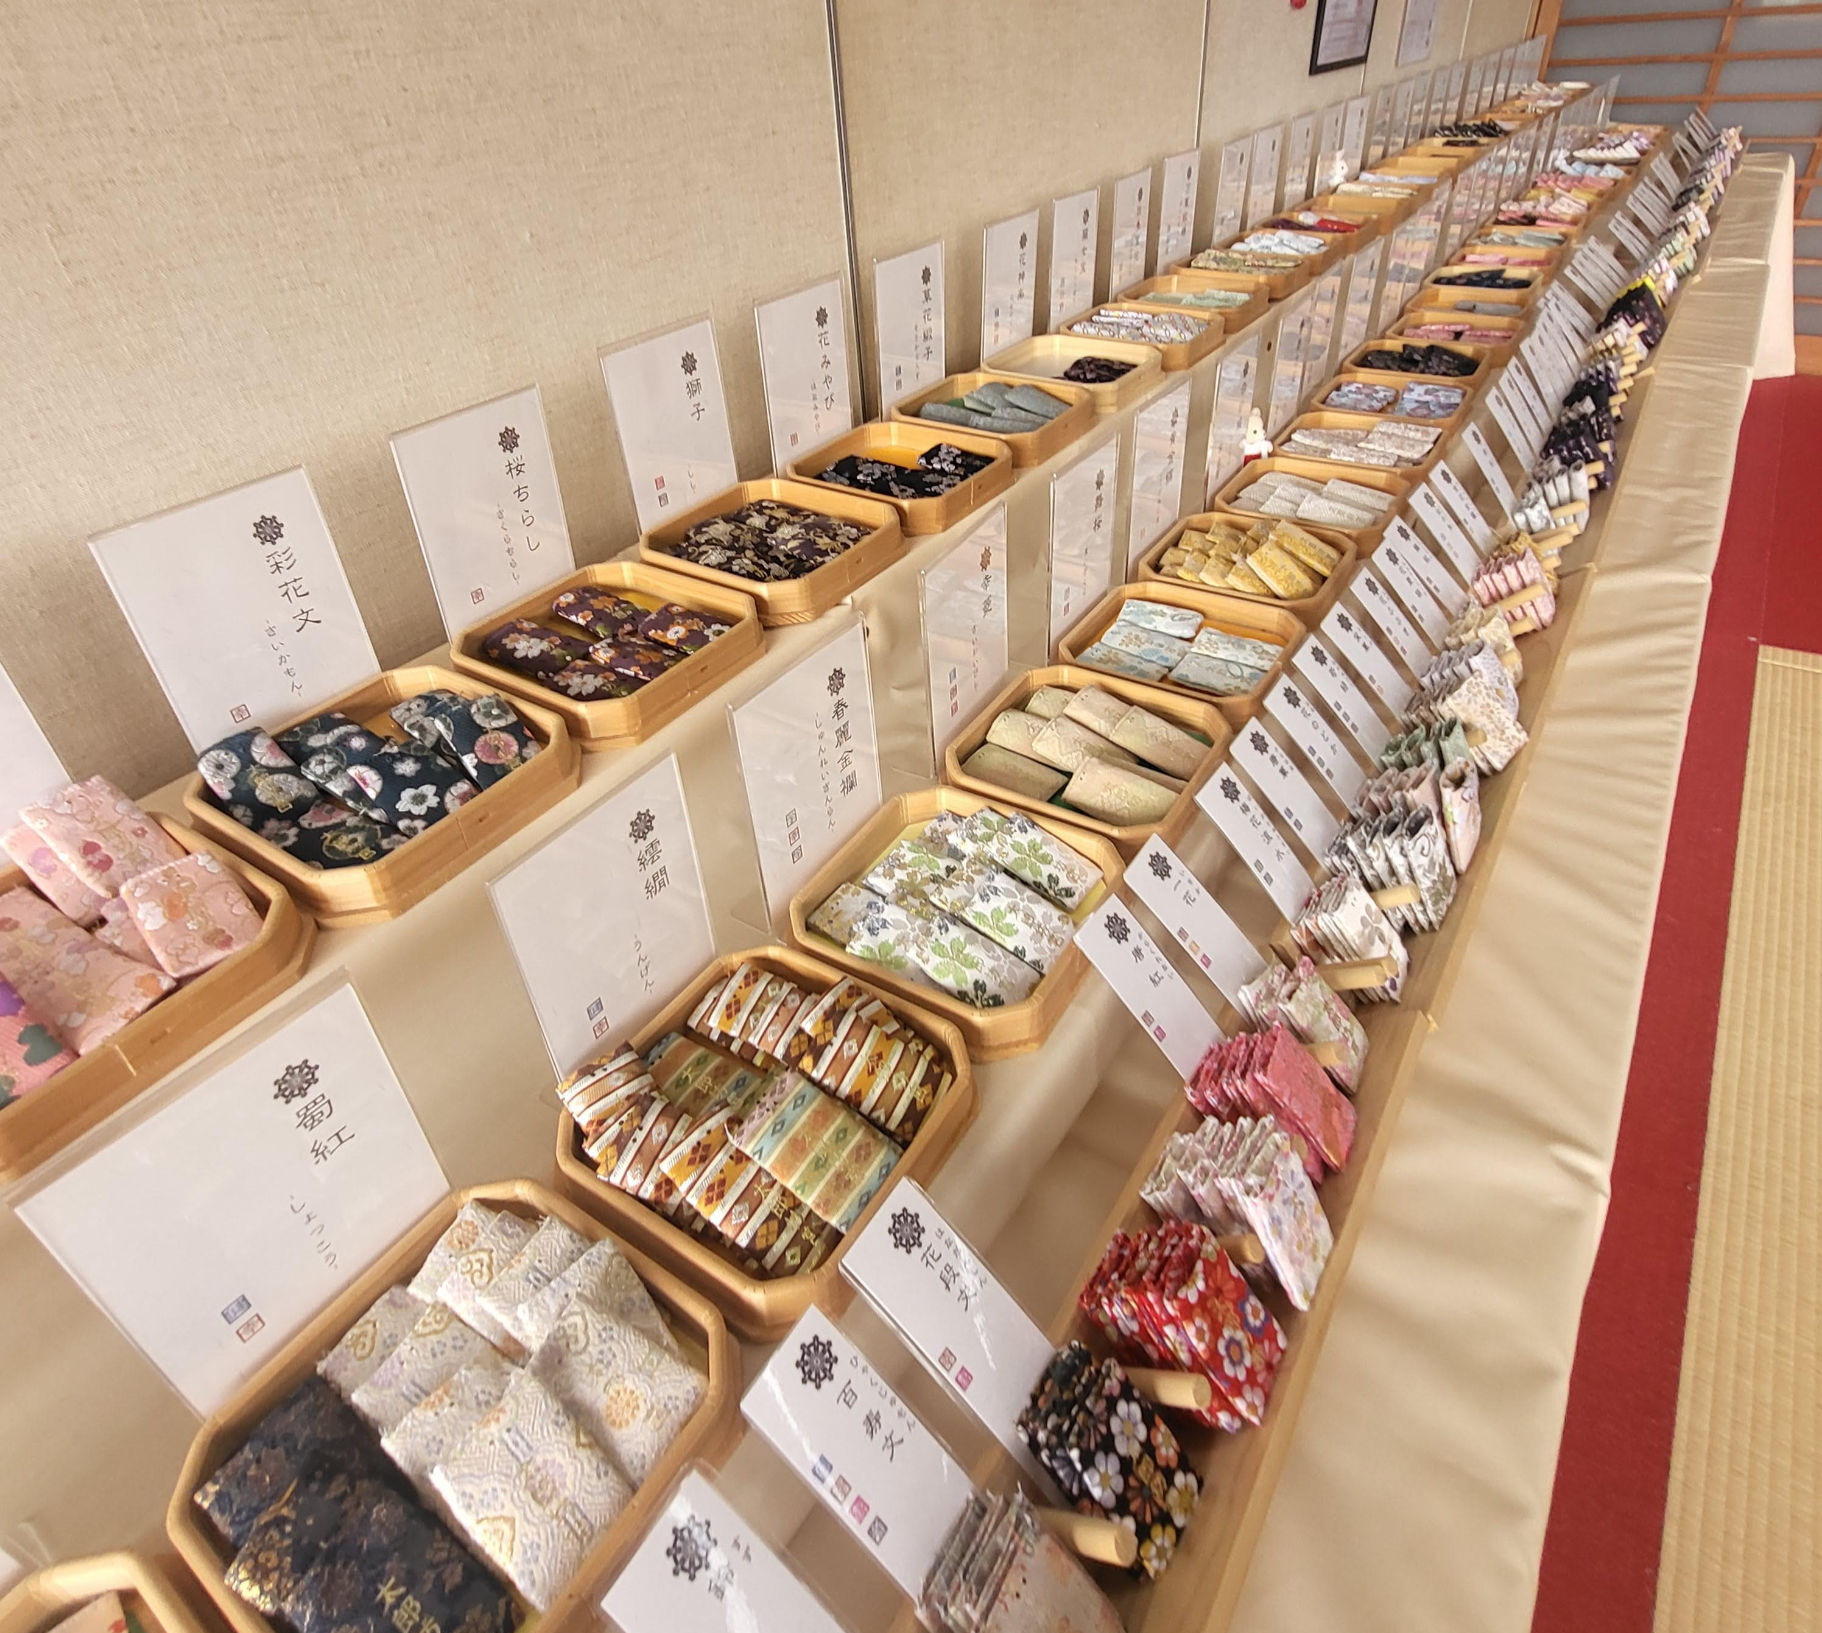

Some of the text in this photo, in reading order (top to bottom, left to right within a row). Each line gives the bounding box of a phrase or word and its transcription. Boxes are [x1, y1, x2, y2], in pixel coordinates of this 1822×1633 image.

[685, 378, 705, 422] 獅子
[818, 331, 835, 410] 花みやび
[506, 456, 541, 551] 桜ちらし
[265, 547, 321, 633] 彩花文
[831, 699, 858, 797] 春麗金襴
[637, 839, 670, 900] 繧繝
[1173, 879, 1197, 908] 一花
[296, 1094, 356, 1165] 蜀紅
[921, 1243, 978, 1312] 花段文
